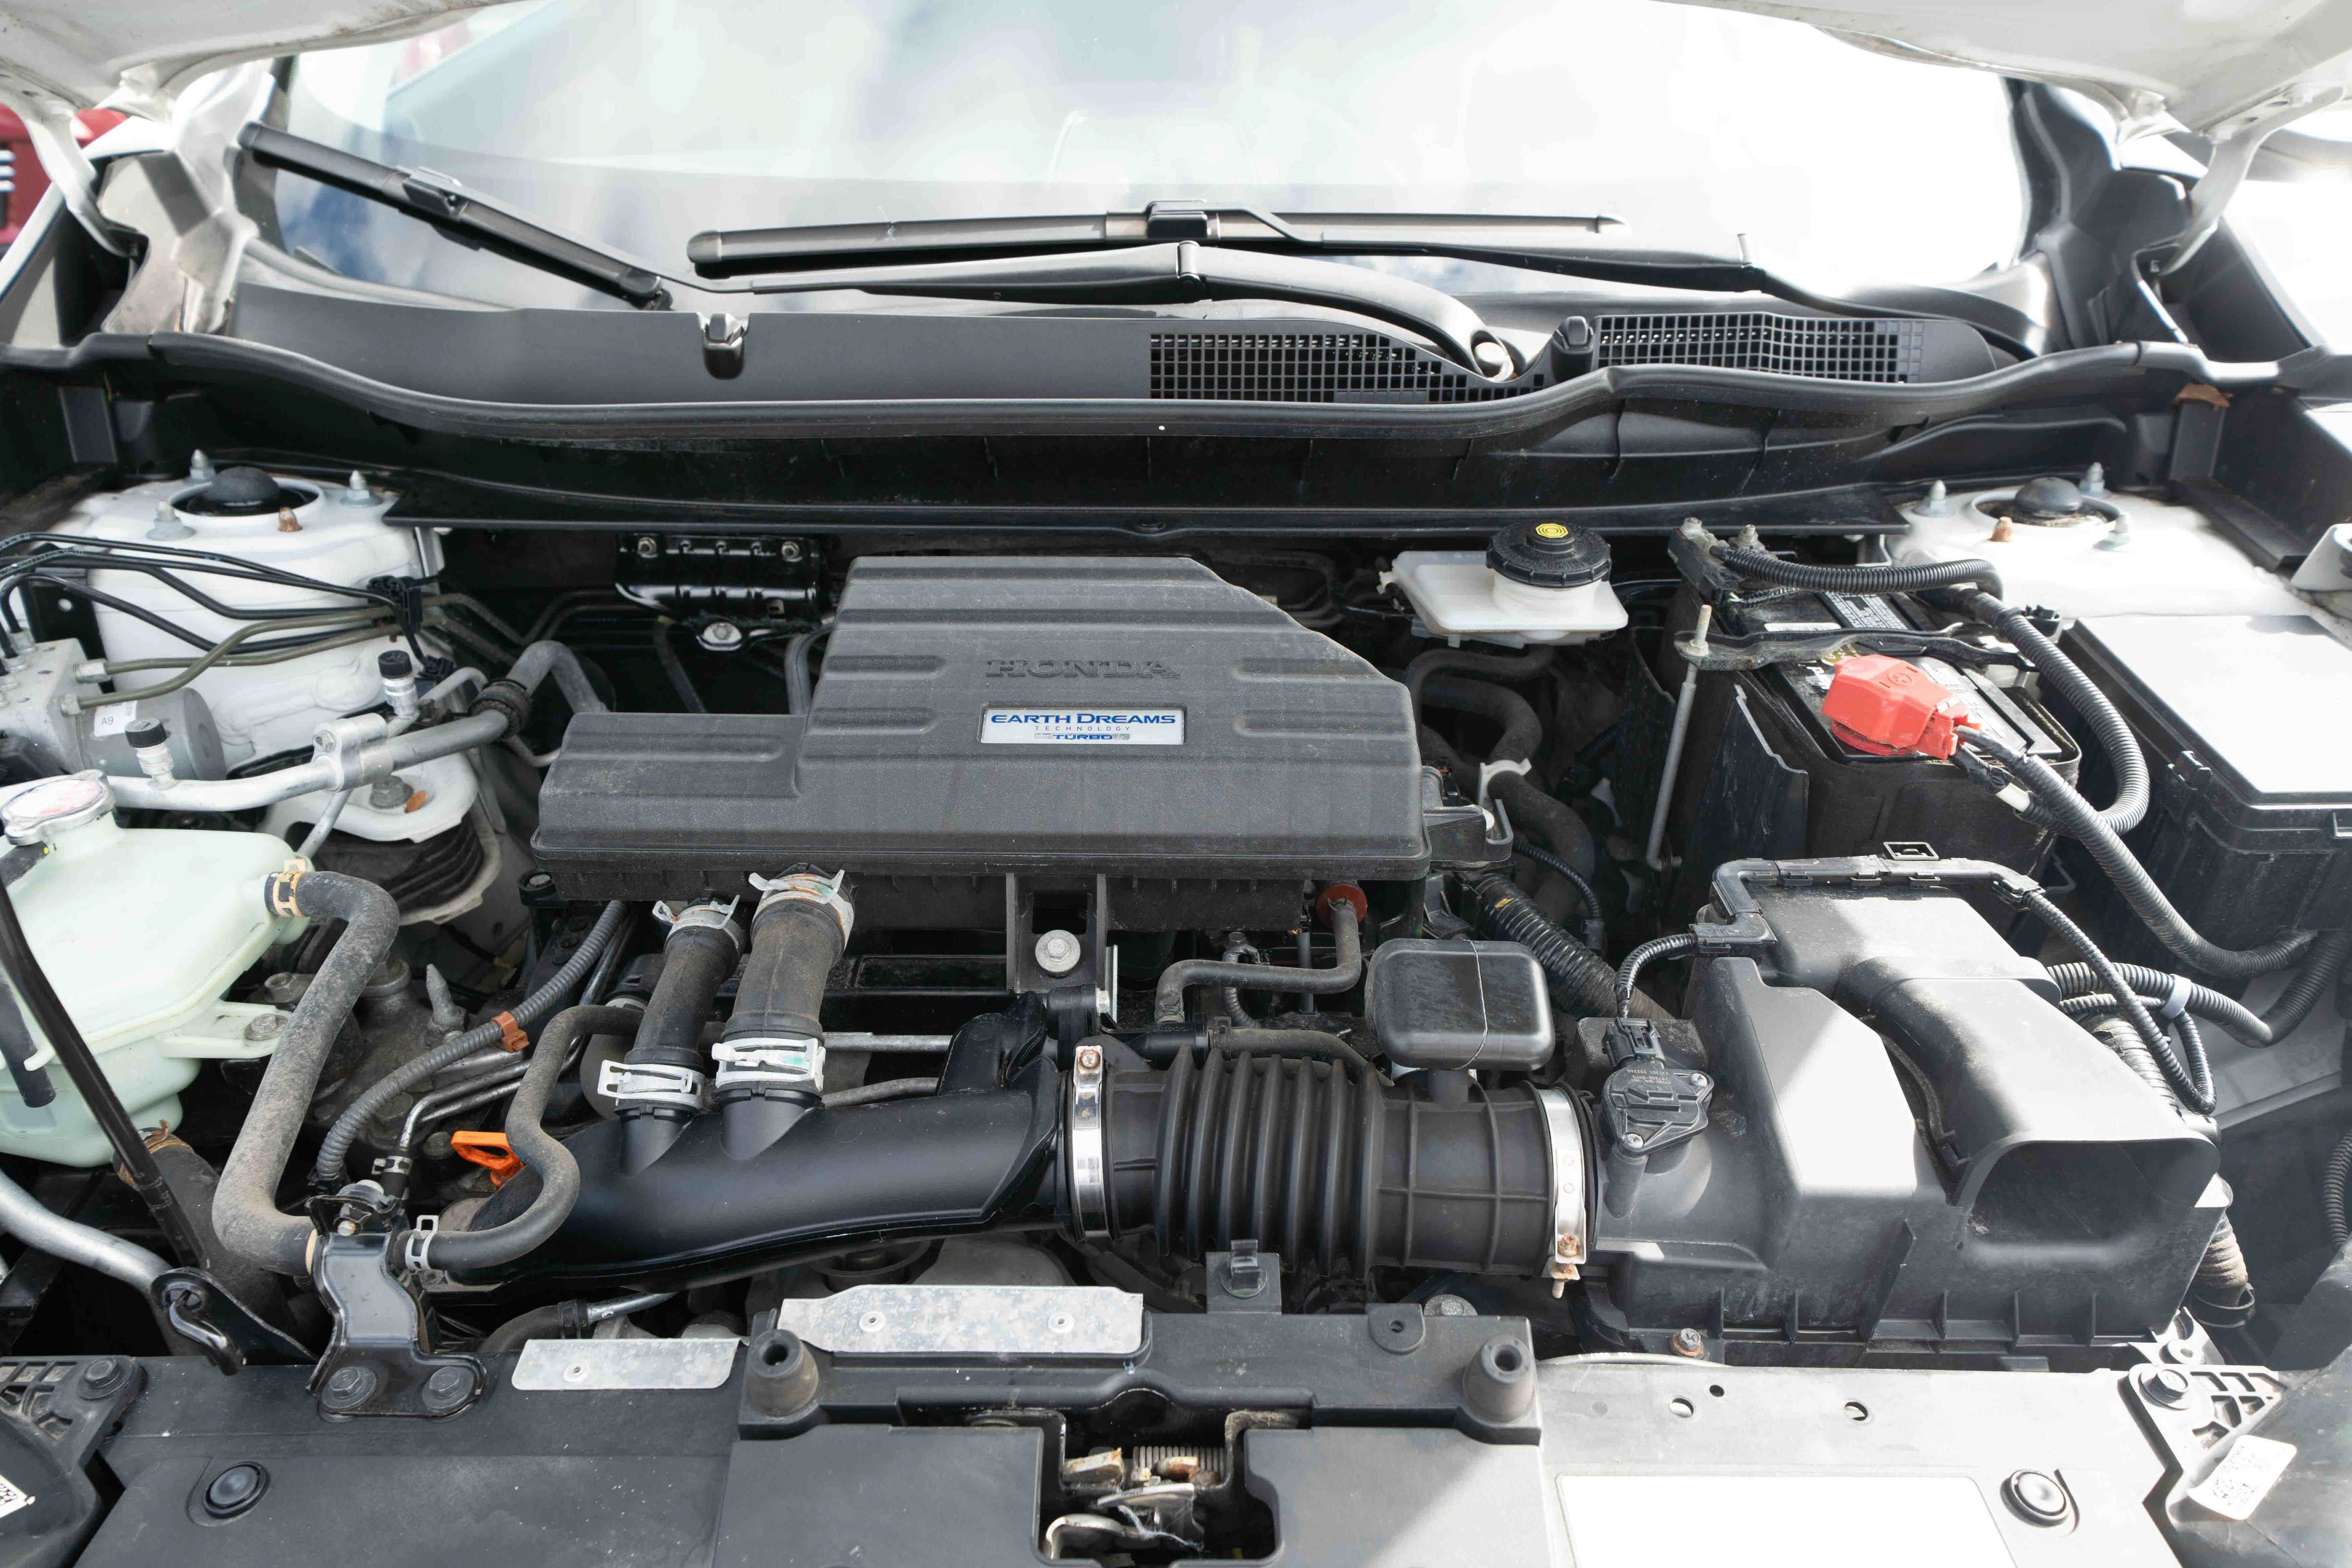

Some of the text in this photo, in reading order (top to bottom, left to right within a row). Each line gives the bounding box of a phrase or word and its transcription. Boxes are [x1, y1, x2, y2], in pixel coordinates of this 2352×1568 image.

[985, 658, 1182, 678] HONDA
[101, 716, 114, 726] A9
[991, 713, 1176, 724] EARTH DREAMS
